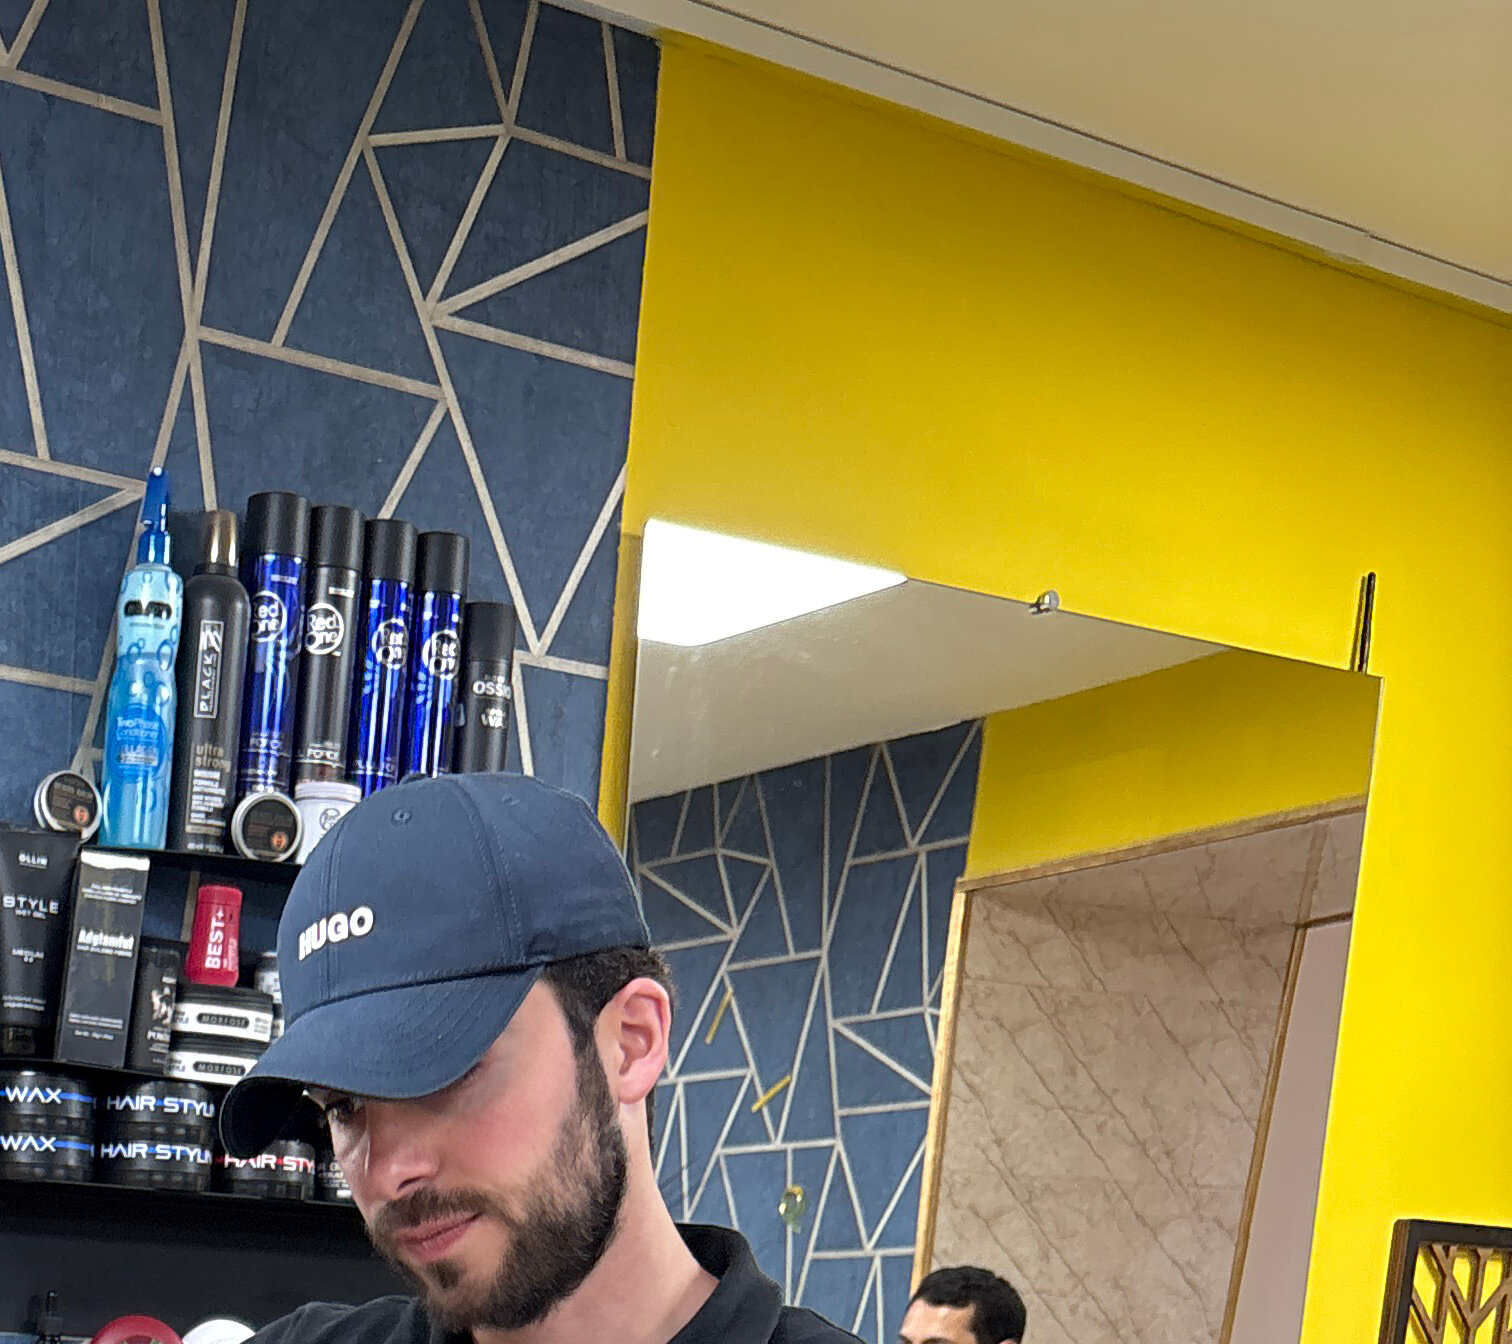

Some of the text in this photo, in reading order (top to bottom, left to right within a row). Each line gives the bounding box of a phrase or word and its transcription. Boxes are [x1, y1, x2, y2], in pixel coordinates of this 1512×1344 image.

[308, 613, 338, 630] Red
[305, 631, 338, 650] One
[196, 742, 224, 757] ultra
[195, 755, 232, 773] strong
[3, 895, 59, 914] STYLE
[298, 906, 374, 961] HUGO
[4, 1086, 63, 1105] WAX
[107, 1095, 156, 1111] HAIR
[0, 1135, 57, 1152] WAX
[100, 1143, 149, 1159] HAIR
[282, 1155, 315, 1175] STY
